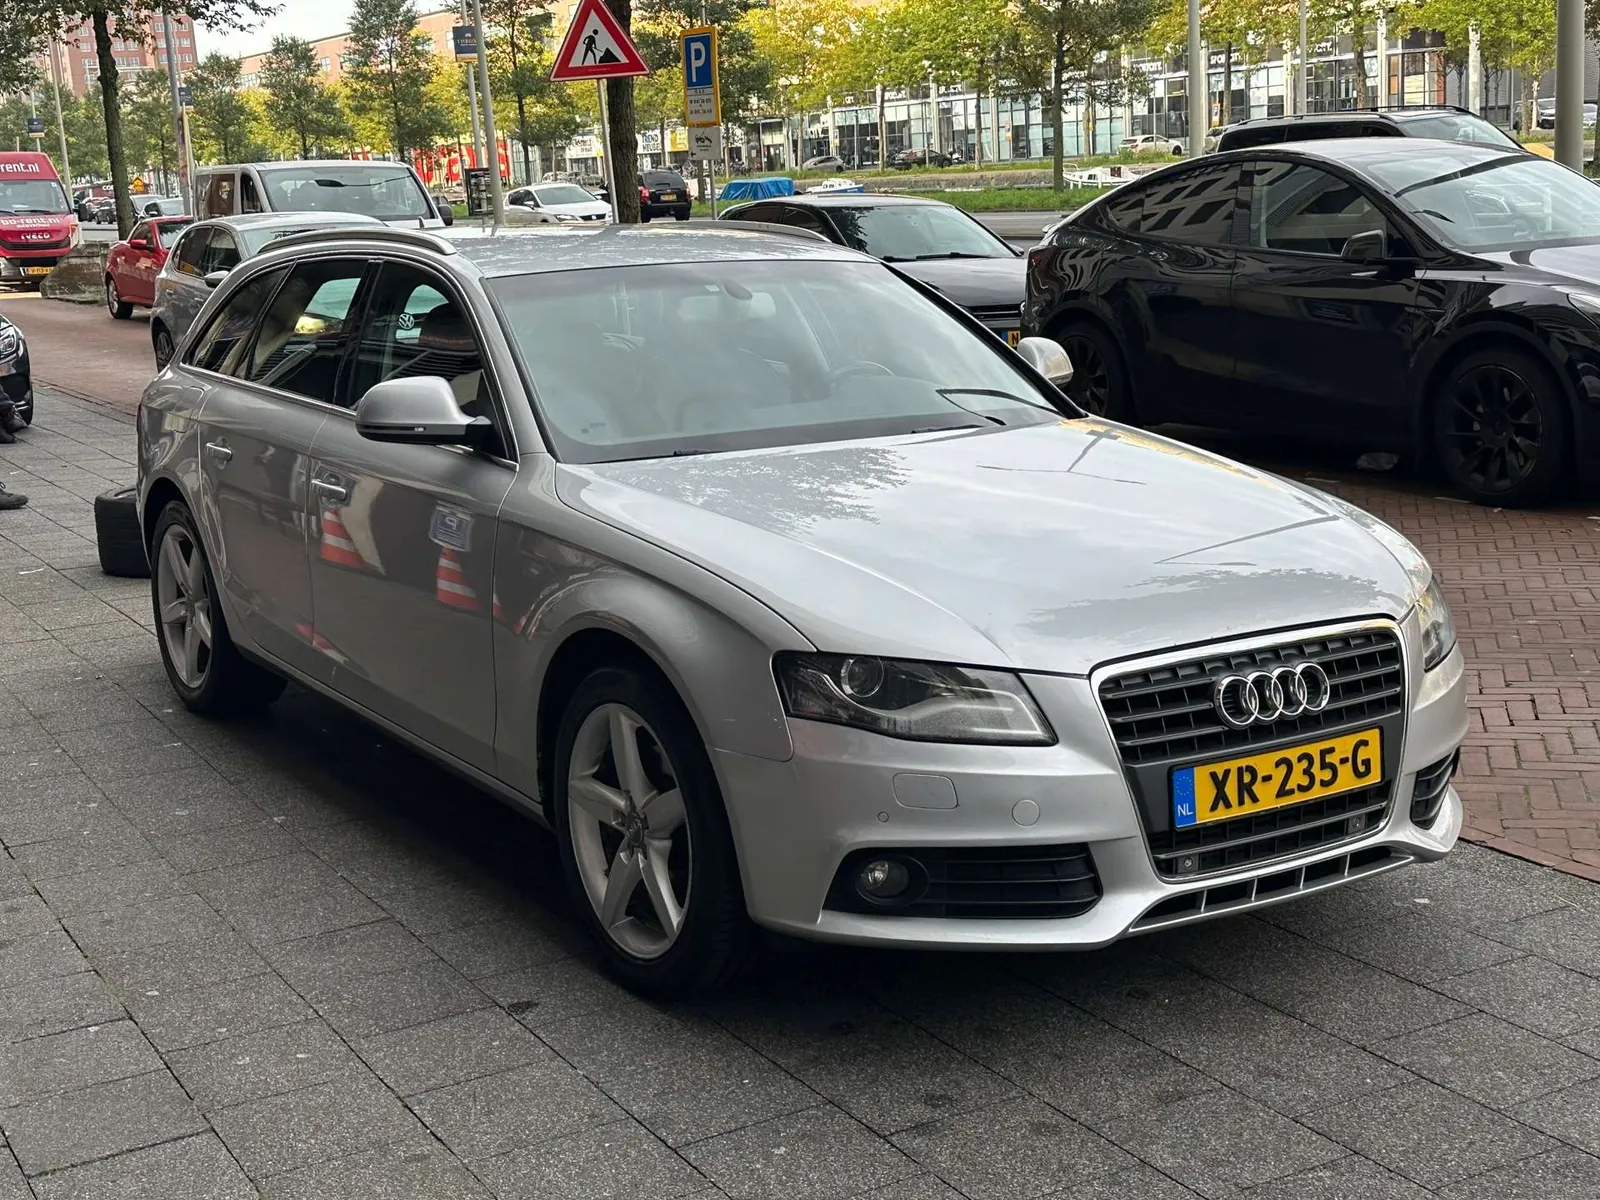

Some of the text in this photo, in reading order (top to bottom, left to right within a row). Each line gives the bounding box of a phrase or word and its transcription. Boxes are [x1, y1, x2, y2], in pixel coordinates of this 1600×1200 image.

[690, 41, 706, 83] P
[21, 232, 50, 240] IVECO
[1208, 738, 1372, 812] XR-235-G
[1177, 802, 1194, 818] NL
